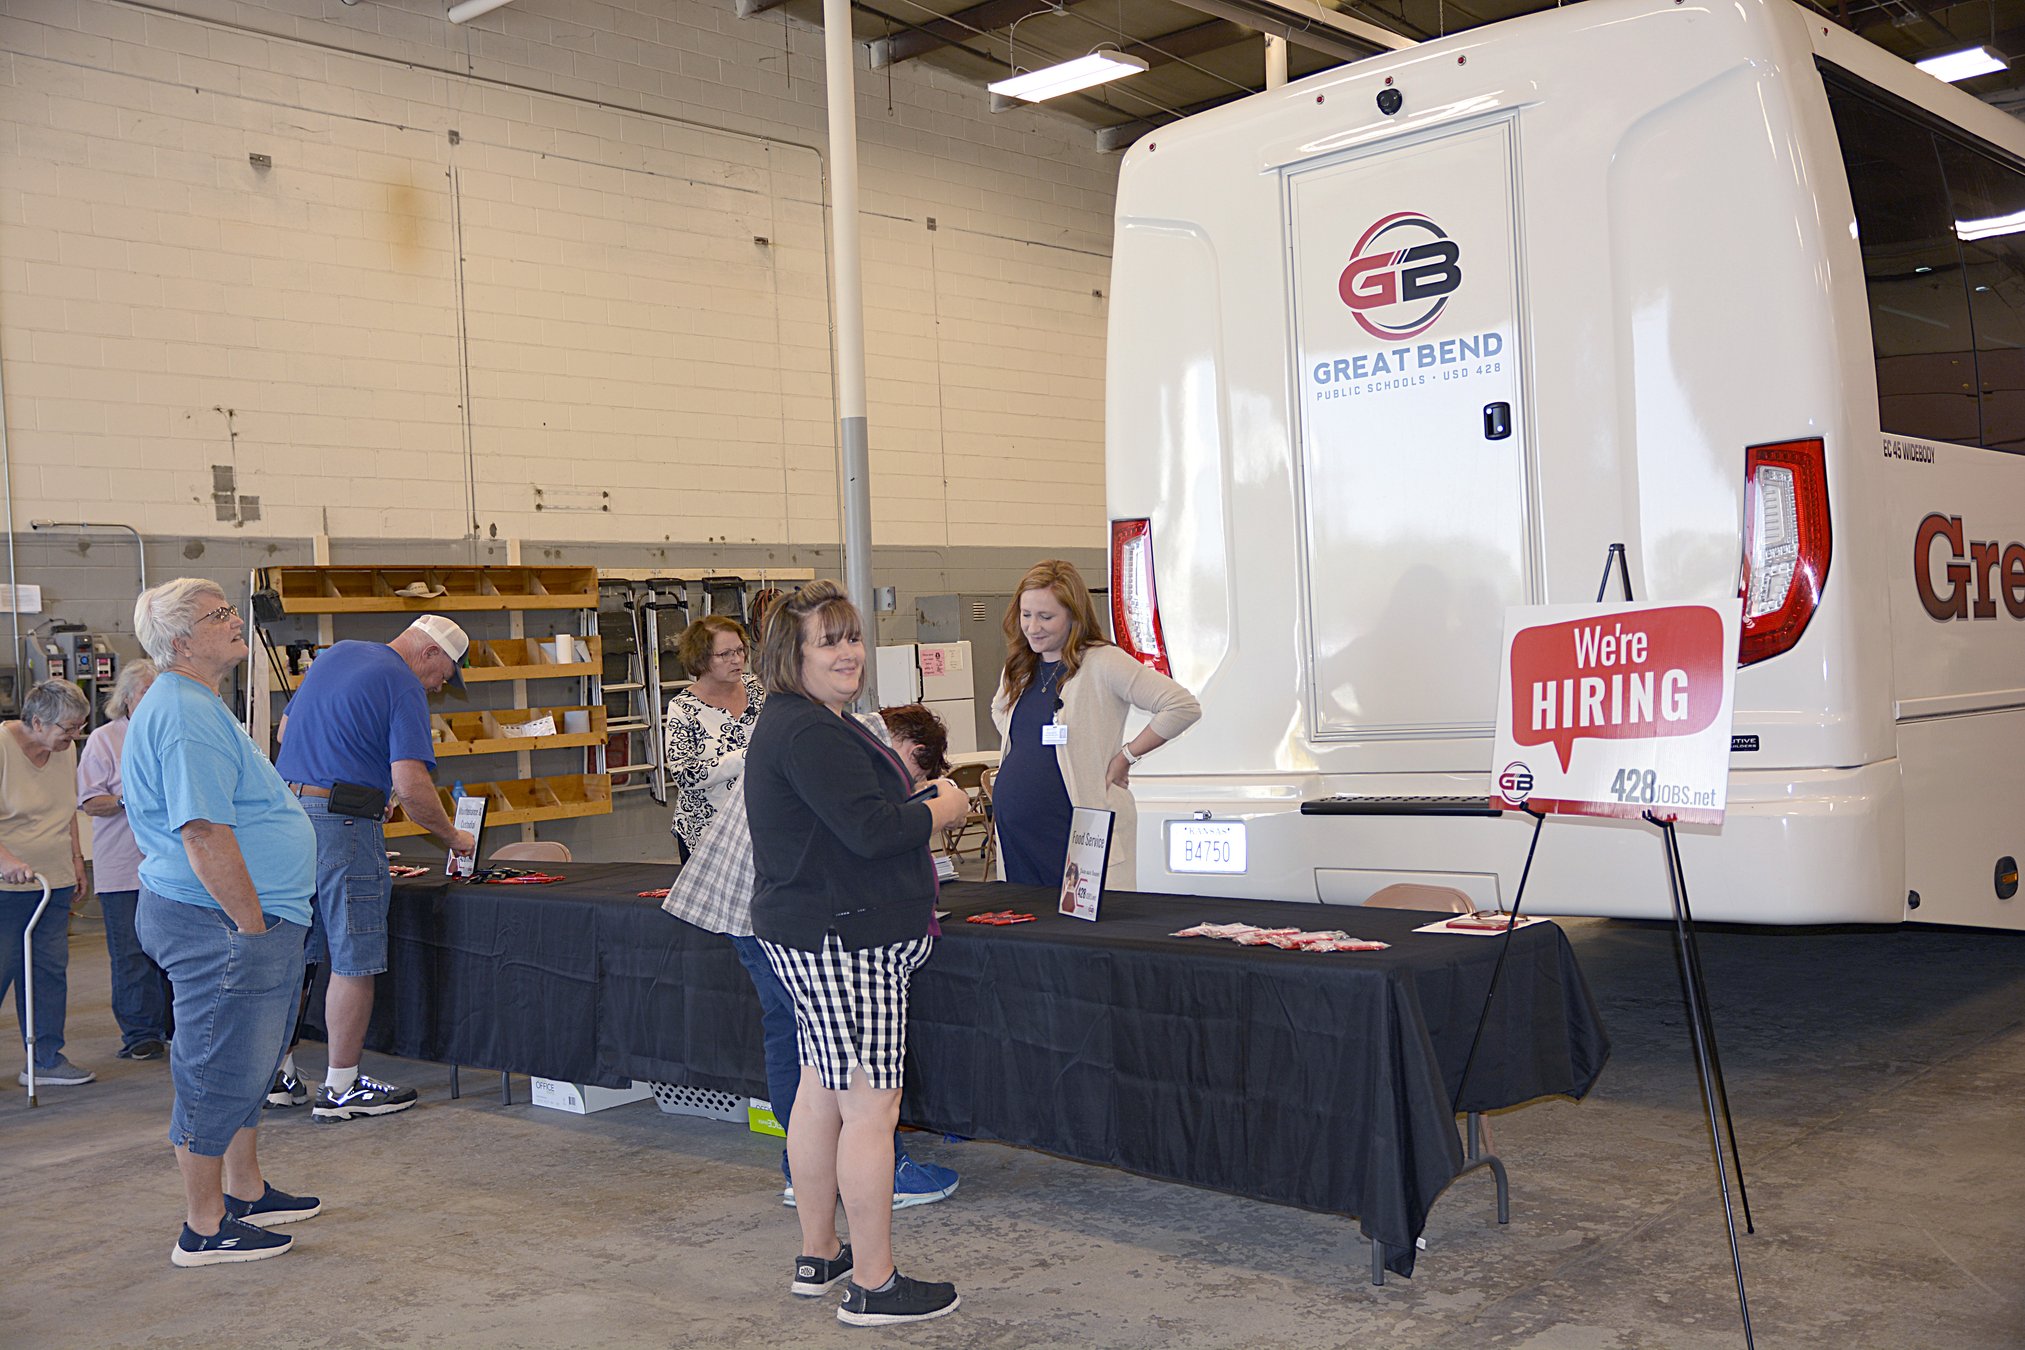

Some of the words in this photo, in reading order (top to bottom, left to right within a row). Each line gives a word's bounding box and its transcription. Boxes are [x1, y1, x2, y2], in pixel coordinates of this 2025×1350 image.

[1338, 240, 1462, 310] GB
[1313, 347, 1410, 385] GREAT
[1417, 332, 1503, 368] BEND
[1316, 385, 1361, 401] PUBLIC
[1367, 375, 1425, 393] SCHOOLS
[1443, 368, 1469, 381] USD
[1476, 362, 1501, 376] 428
[1883, 439, 1893, 458] EC
[1893, 442, 1902, 460] 45
[1902, 442, 1935, 464] WIDEBODY
[1574, 623, 1648, 669] We're
[1531, 668, 1689, 731] HIRING
[1071, 830, 1085, 846] Food
[1085, 833, 1105, 849] Service
[1185, 840, 1231, 863] B4750
[535, 1081, 555, 1092] OFFICE
